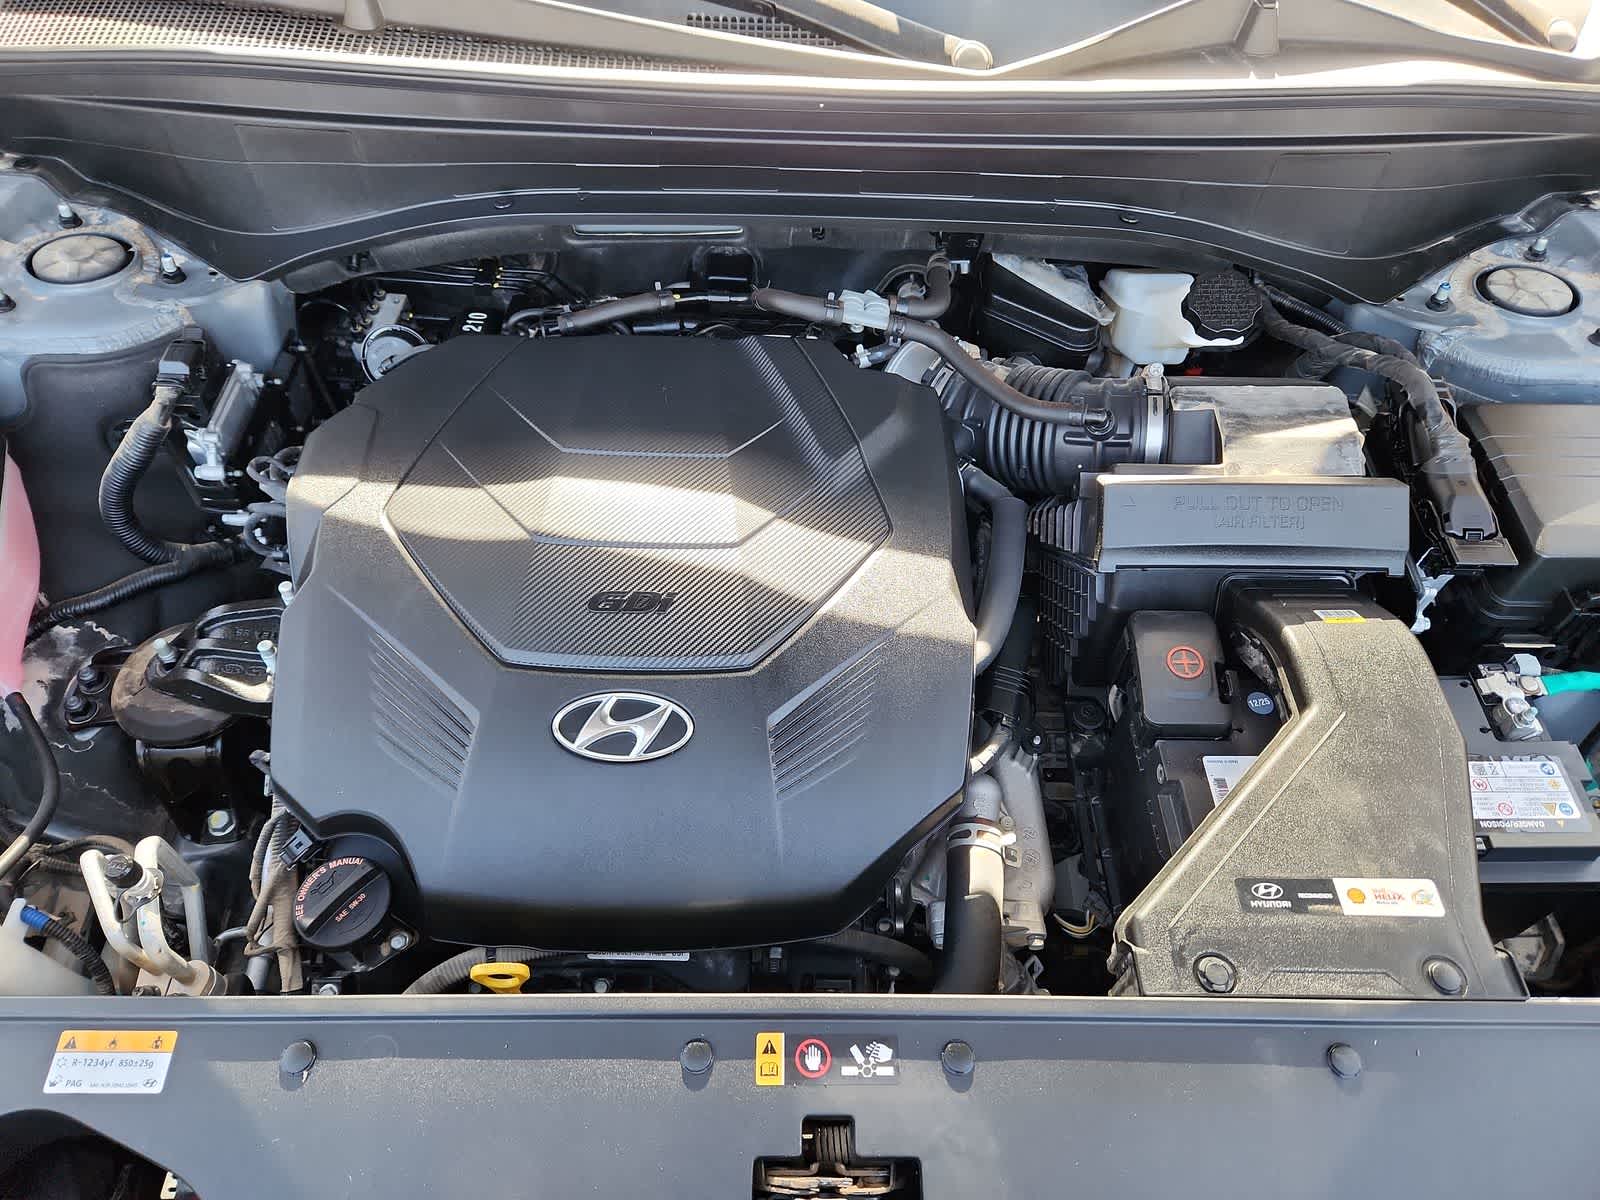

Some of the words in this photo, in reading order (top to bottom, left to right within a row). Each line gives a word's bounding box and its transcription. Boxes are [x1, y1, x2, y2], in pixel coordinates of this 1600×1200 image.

[462, 312, 488, 333] 210
[1173, 495, 1218, 511] PULL
[1224, 495, 1263, 511] OUT
[1267, 495, 1292, 511] TO
[1296, 495, 1344, 512] OPEN
[1248, 698, 1271, 708] 12/25
[297, 866, 327, 902] OWNER'S
[1250, 900, 1292, 909] HYUNDAI
[72, 1058, 114, 1068] R-1234yf
[65, 1079, 83, 1088] PAG
